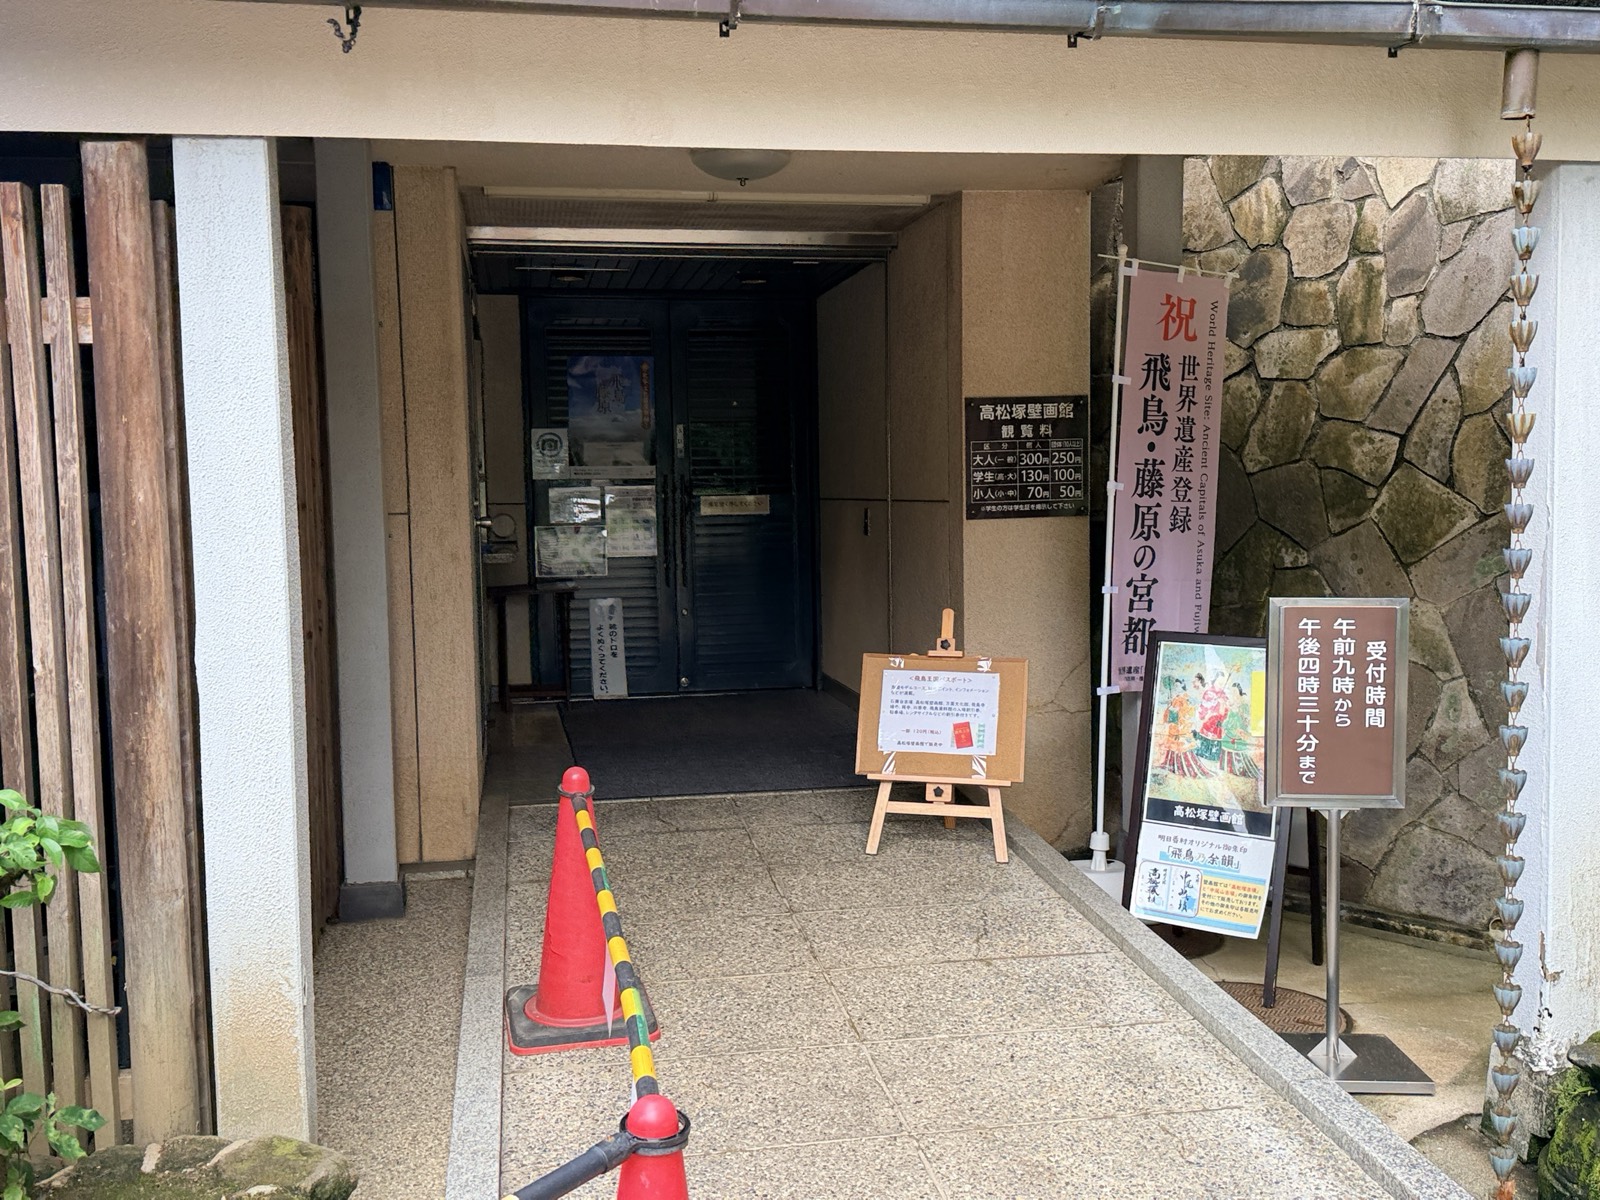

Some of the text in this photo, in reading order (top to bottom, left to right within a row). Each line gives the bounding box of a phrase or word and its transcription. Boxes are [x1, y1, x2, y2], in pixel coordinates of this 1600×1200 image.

[1156, 293, 1198, 342] 祝
[1209, 300, 1218, 337] World
[1204, 341, 1216, 391] Heritage
[979, 402, 1074, 420] 高松塚壁画館
[1203, 395, 1213, 420] Site:
[1001, 424, 1053, 438] 観覧料
[1168, 355, 1200, 533] 世界遺産登録
[1201, 424, 1211, 469] Ancient
[1121, 353, 1171, 656] 飛鳥・藤原の宮都
[1197, 473, 1208, 520] Capitals
[1197, 523, 1207, 536] of
[1195, 539, 1206, 575] Asuka
[1194, 579, 1203, 600] and
[1332, 617, 1357, 727] 午前九時から
[1365, 640, 1387, 728] 受付時間
[1296, 617, 1321, 785] 午後四時三十分まで
[1173, 804, 1244, 825] 高松塚壁画館
